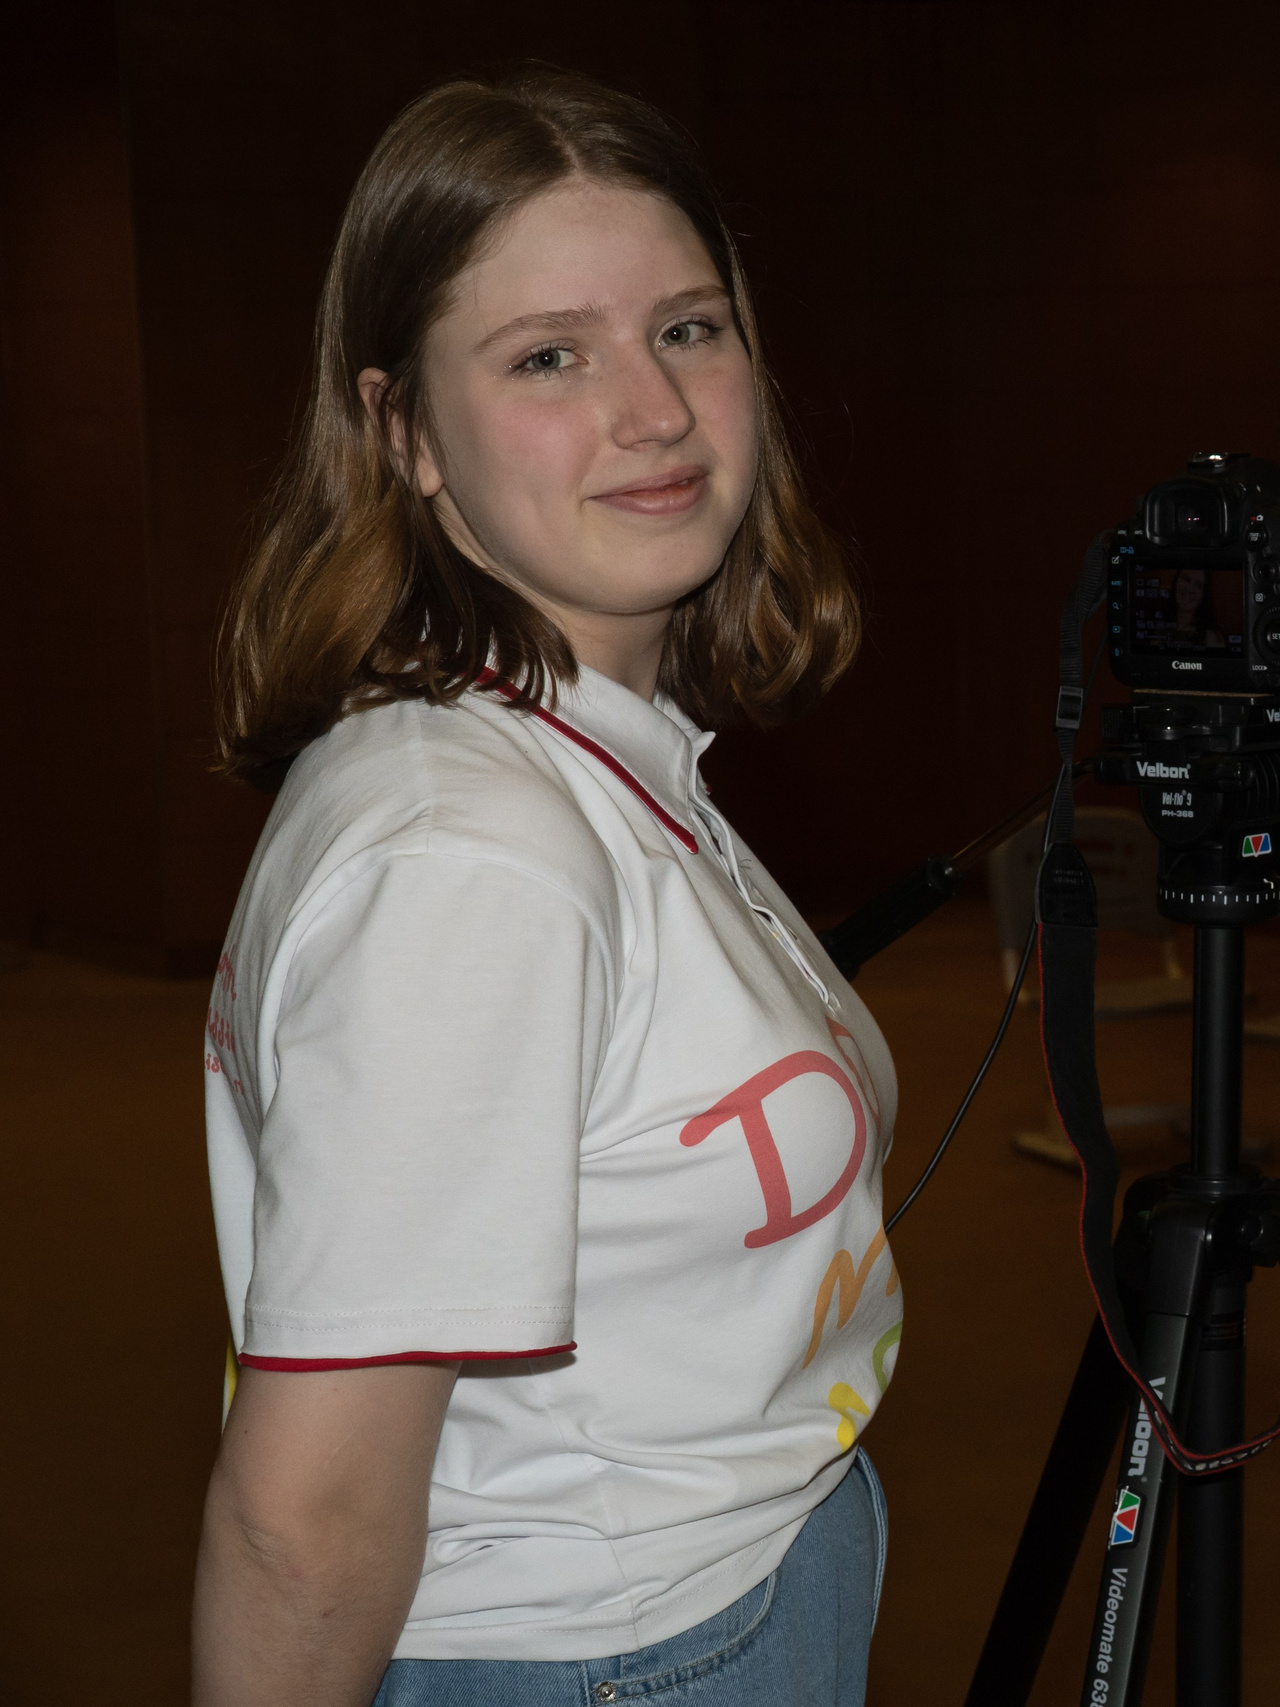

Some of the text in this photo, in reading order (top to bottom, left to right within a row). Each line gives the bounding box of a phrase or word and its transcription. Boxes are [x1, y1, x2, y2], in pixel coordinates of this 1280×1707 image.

[1172, 660, 1202, 671] Canon
[1136, 760, 1190, 779] Velbon
[1096, 1567, 1129, 1674] Videomate
